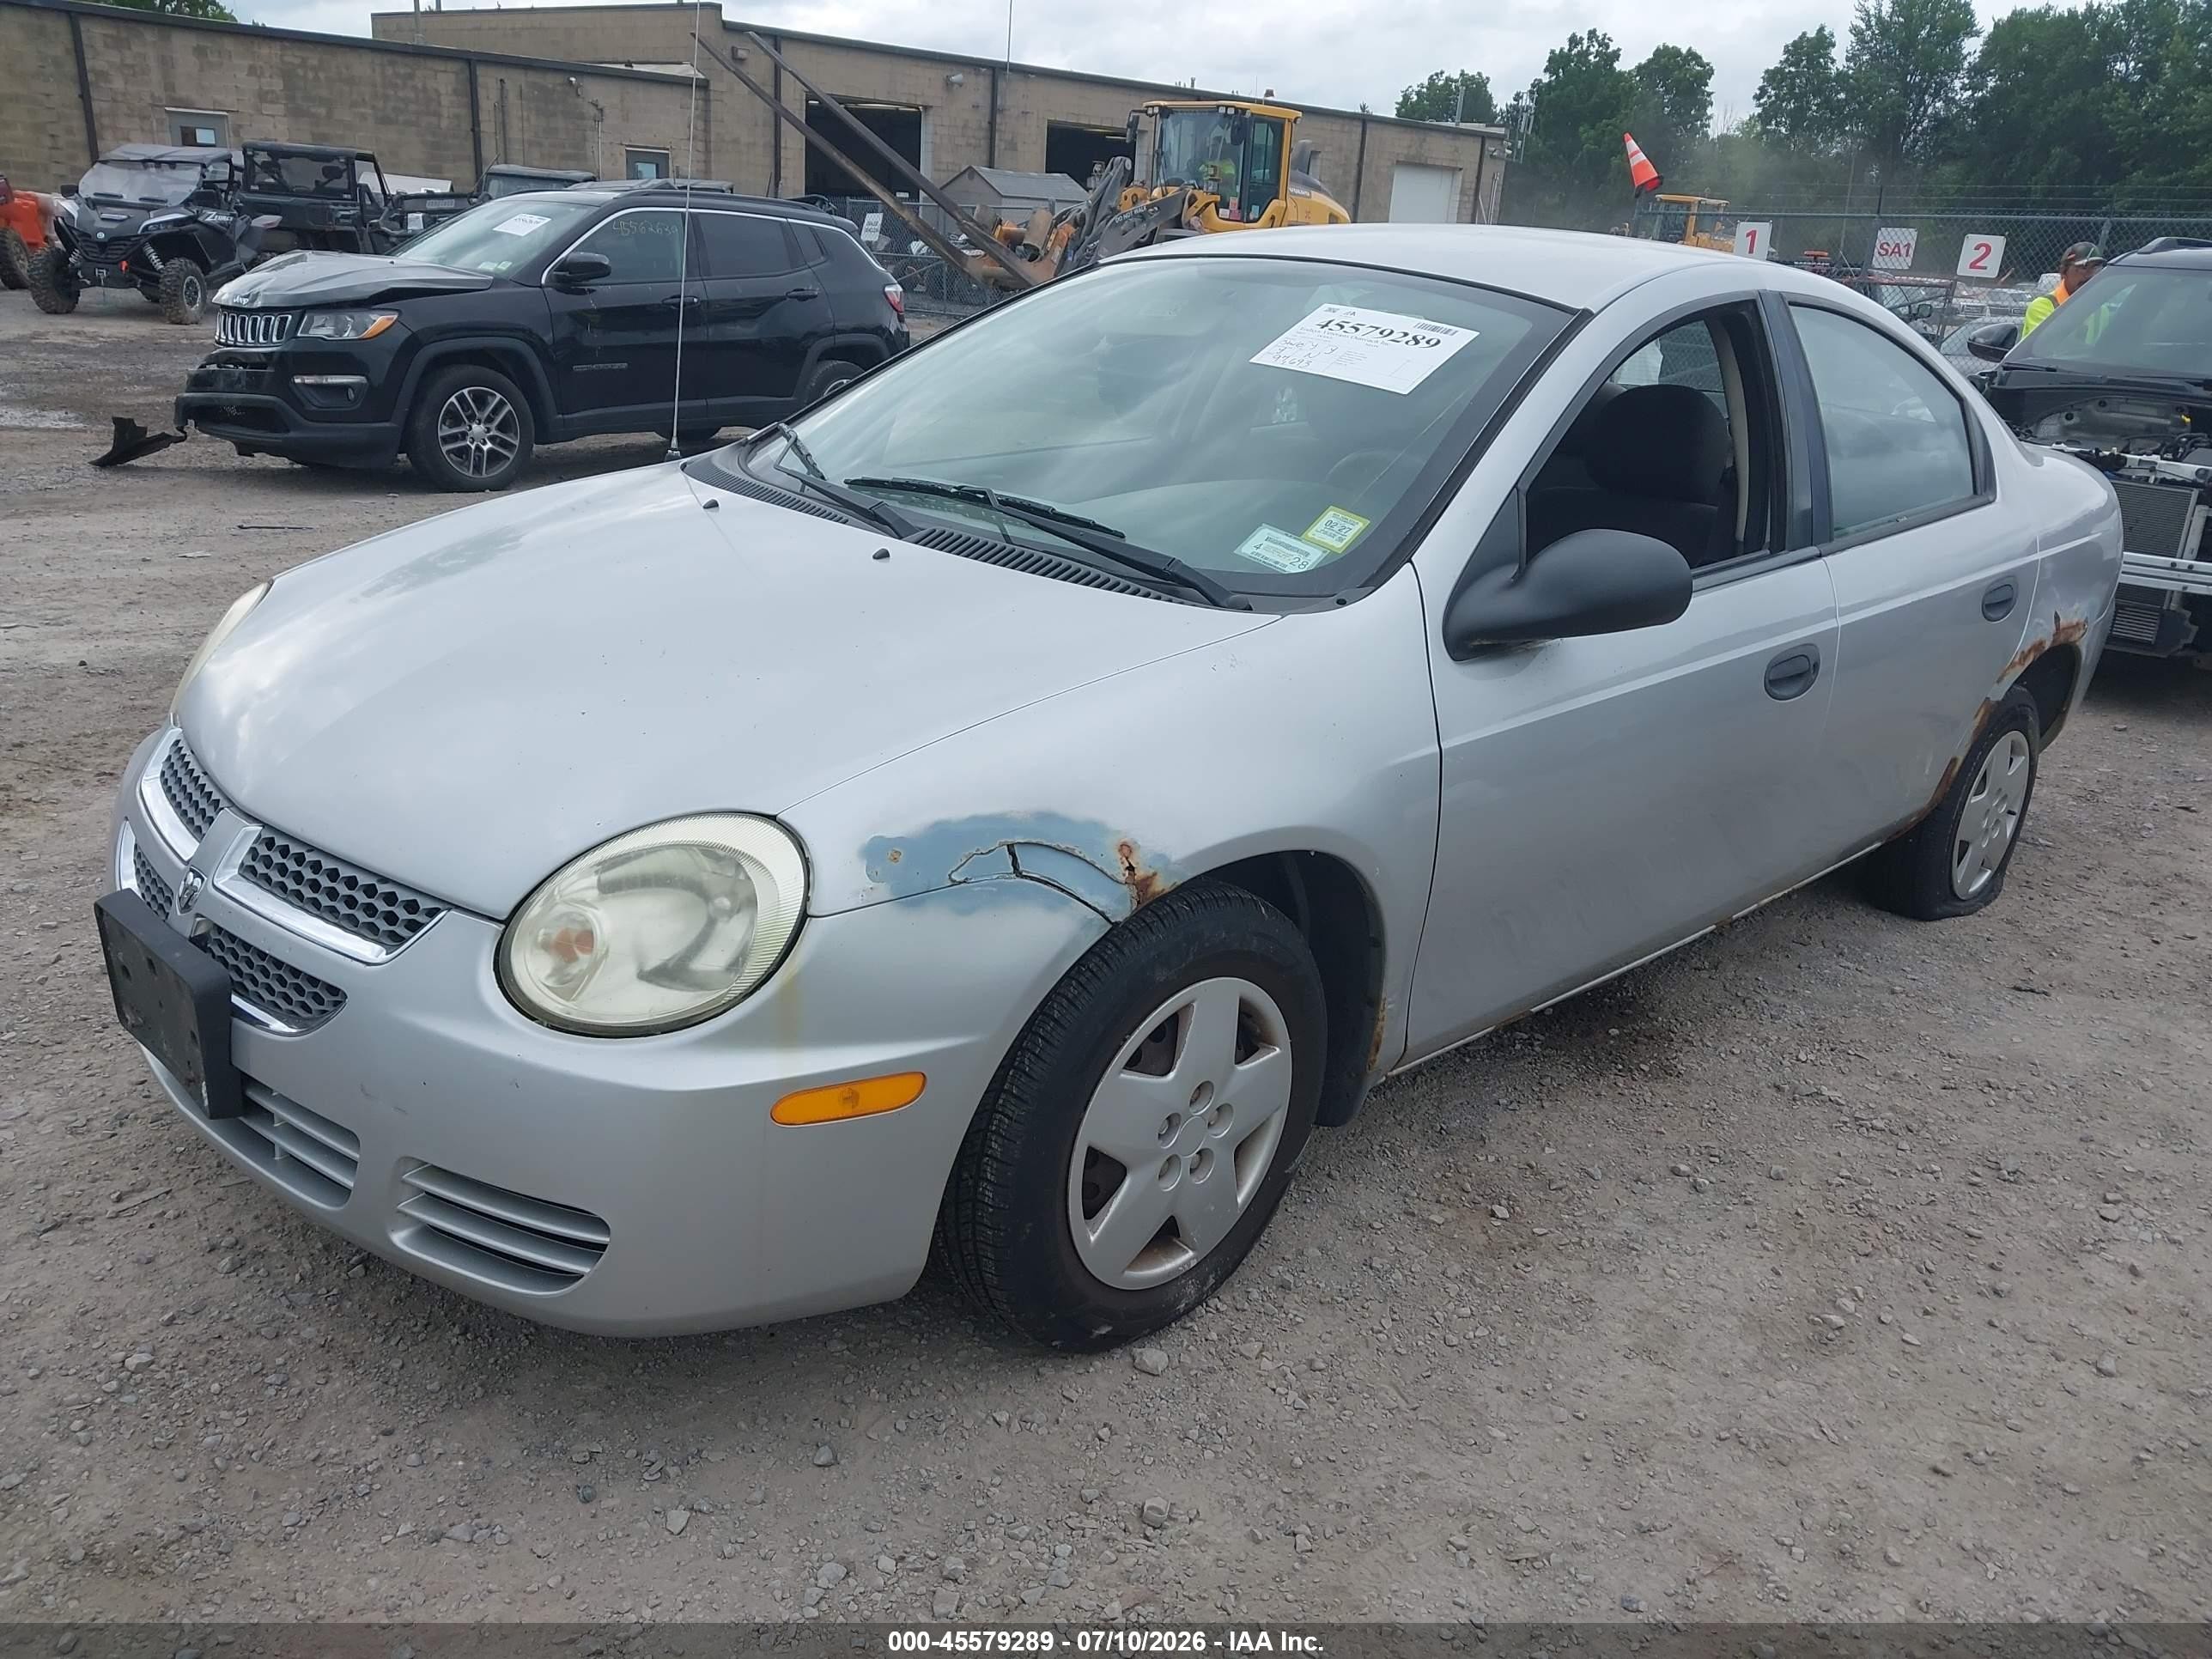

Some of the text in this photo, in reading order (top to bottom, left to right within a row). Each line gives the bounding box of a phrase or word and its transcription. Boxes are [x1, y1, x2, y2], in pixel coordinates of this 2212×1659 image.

[1746, 229, 1757, 254] 1
[1877, 241, 1911, 258] SA1
[1969, 243, 1992, 270] 2
[1316, 318, 1442, 349] 45579289
[1253, 543, 1264, 551] 4
[1289, 556, 1310, 570] 28
